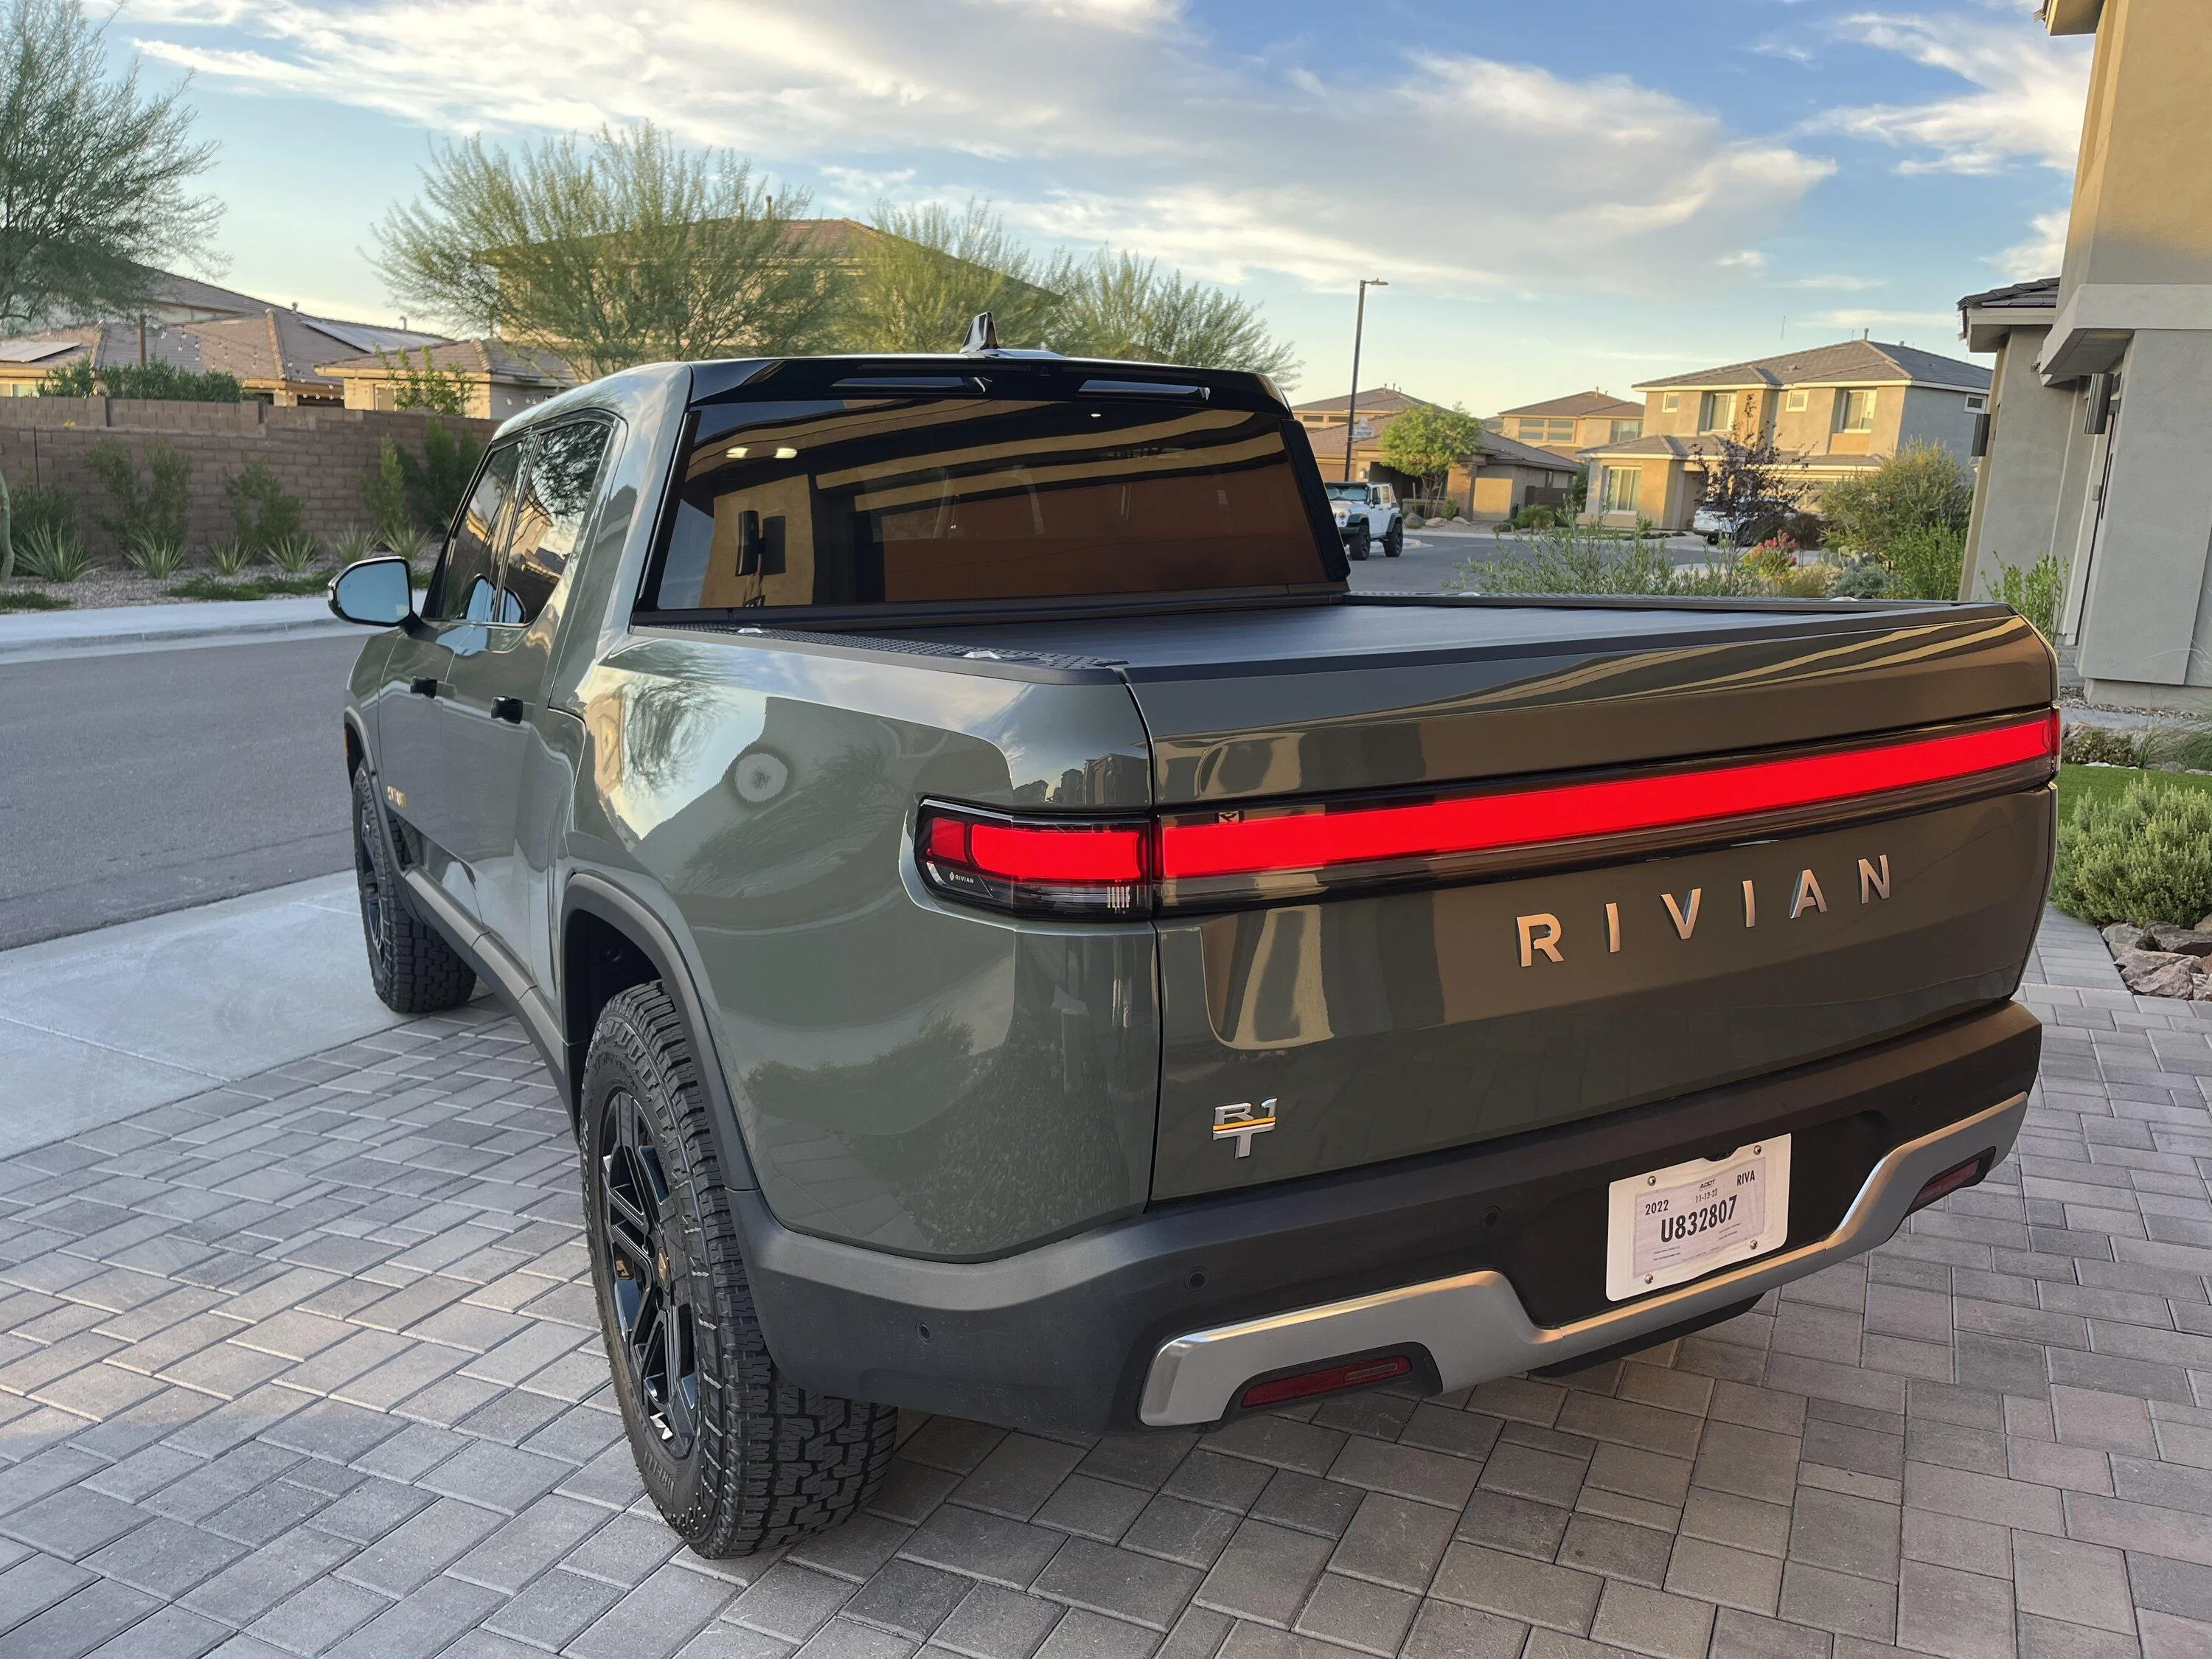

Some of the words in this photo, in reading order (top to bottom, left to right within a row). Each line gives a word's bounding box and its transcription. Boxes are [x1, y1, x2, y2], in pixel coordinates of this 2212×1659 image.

[955, 874, 974, 884] RIVIAN
[1516, 854, 1891, 967] RIVIAN
[1699, 1179, 1717, 1189] ADOT
[1736, 1169, 1756, 1186] RIVA
[1695, 1188, 1719, 1203] 11-13-22
[1645, 1199, 1669, 1216] 2022
[1660, 1194, 1738, 1243] U832807
